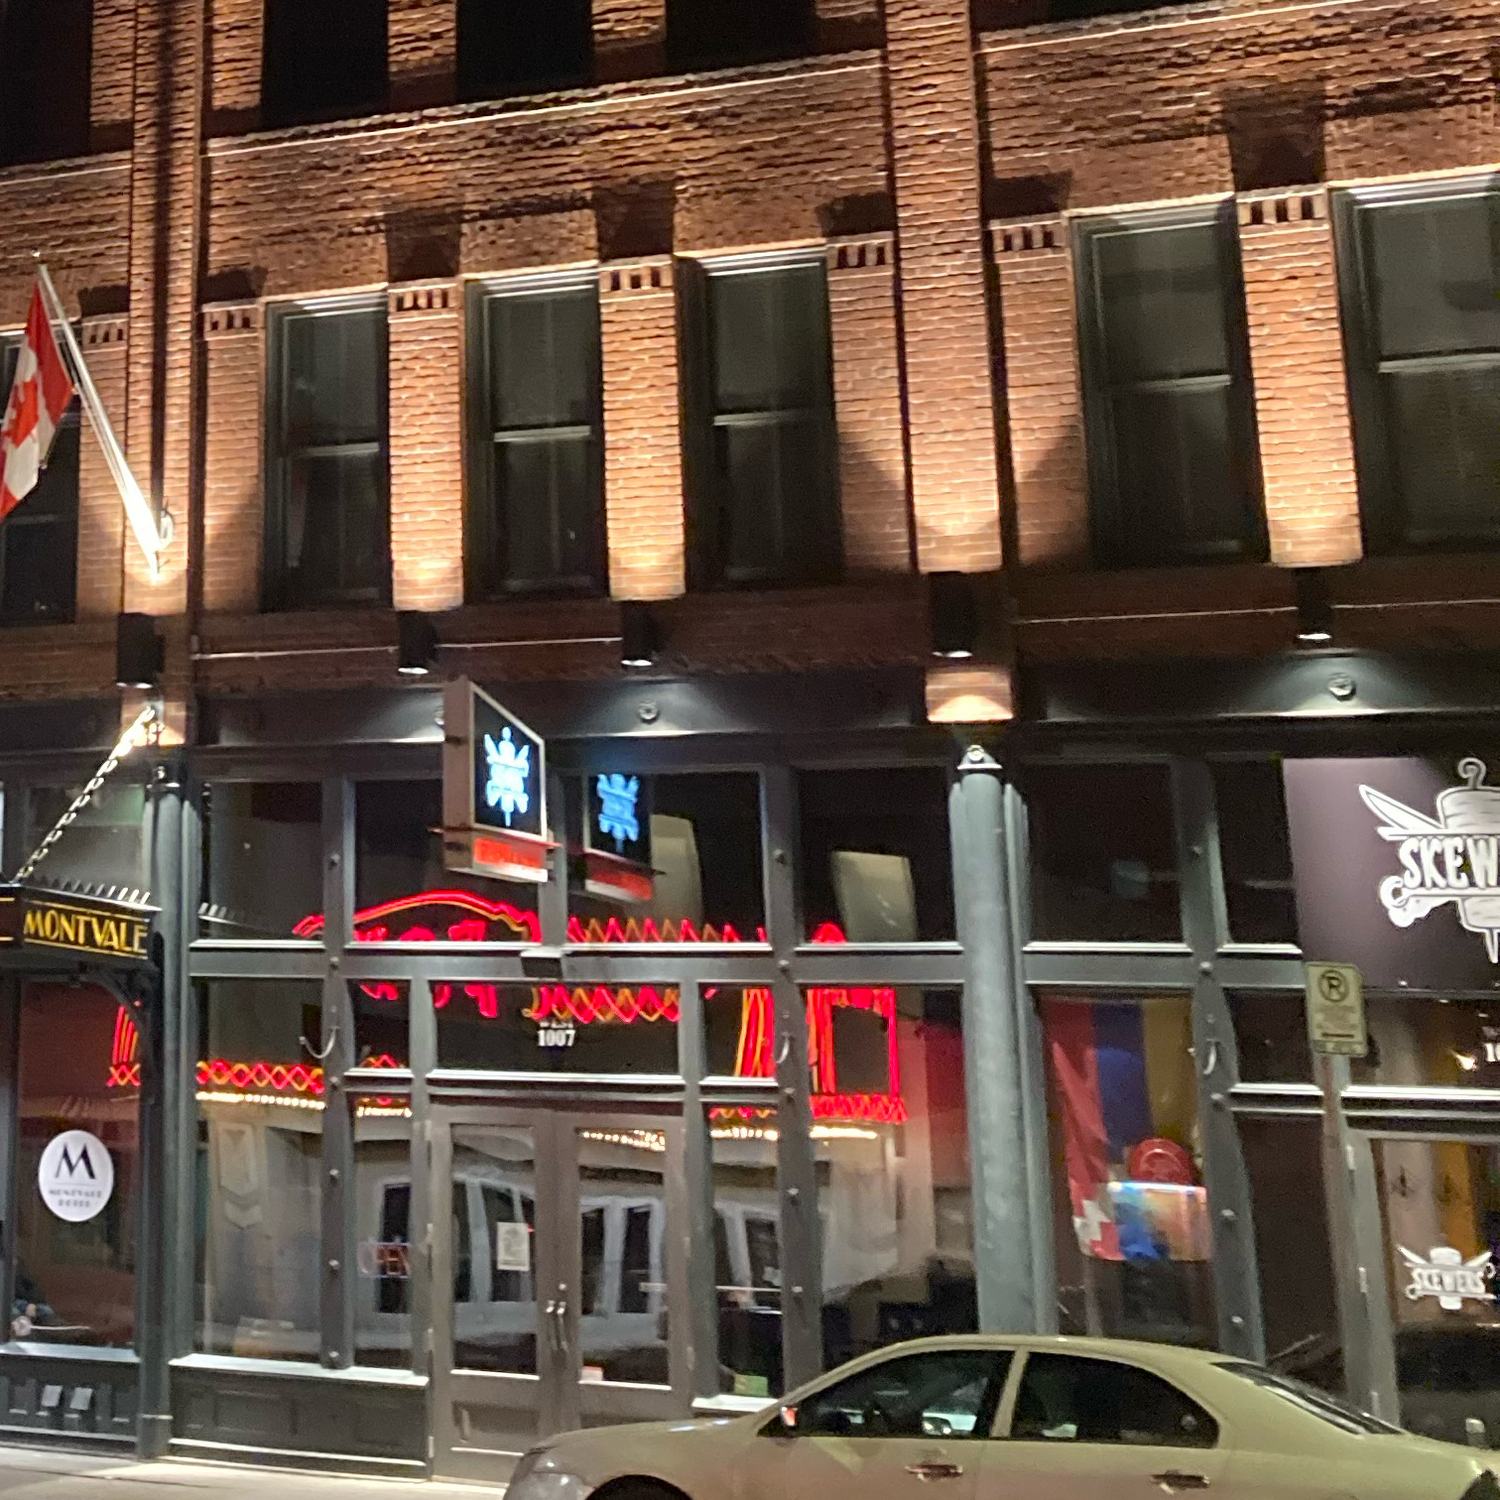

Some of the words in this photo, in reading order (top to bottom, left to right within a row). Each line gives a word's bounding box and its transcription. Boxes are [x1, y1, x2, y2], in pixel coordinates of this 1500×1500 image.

[23, 908, 149, 955] MONTVALE
[537, 1029, 576, 1047] 1007
[54, 1143, 96, 1180] M
